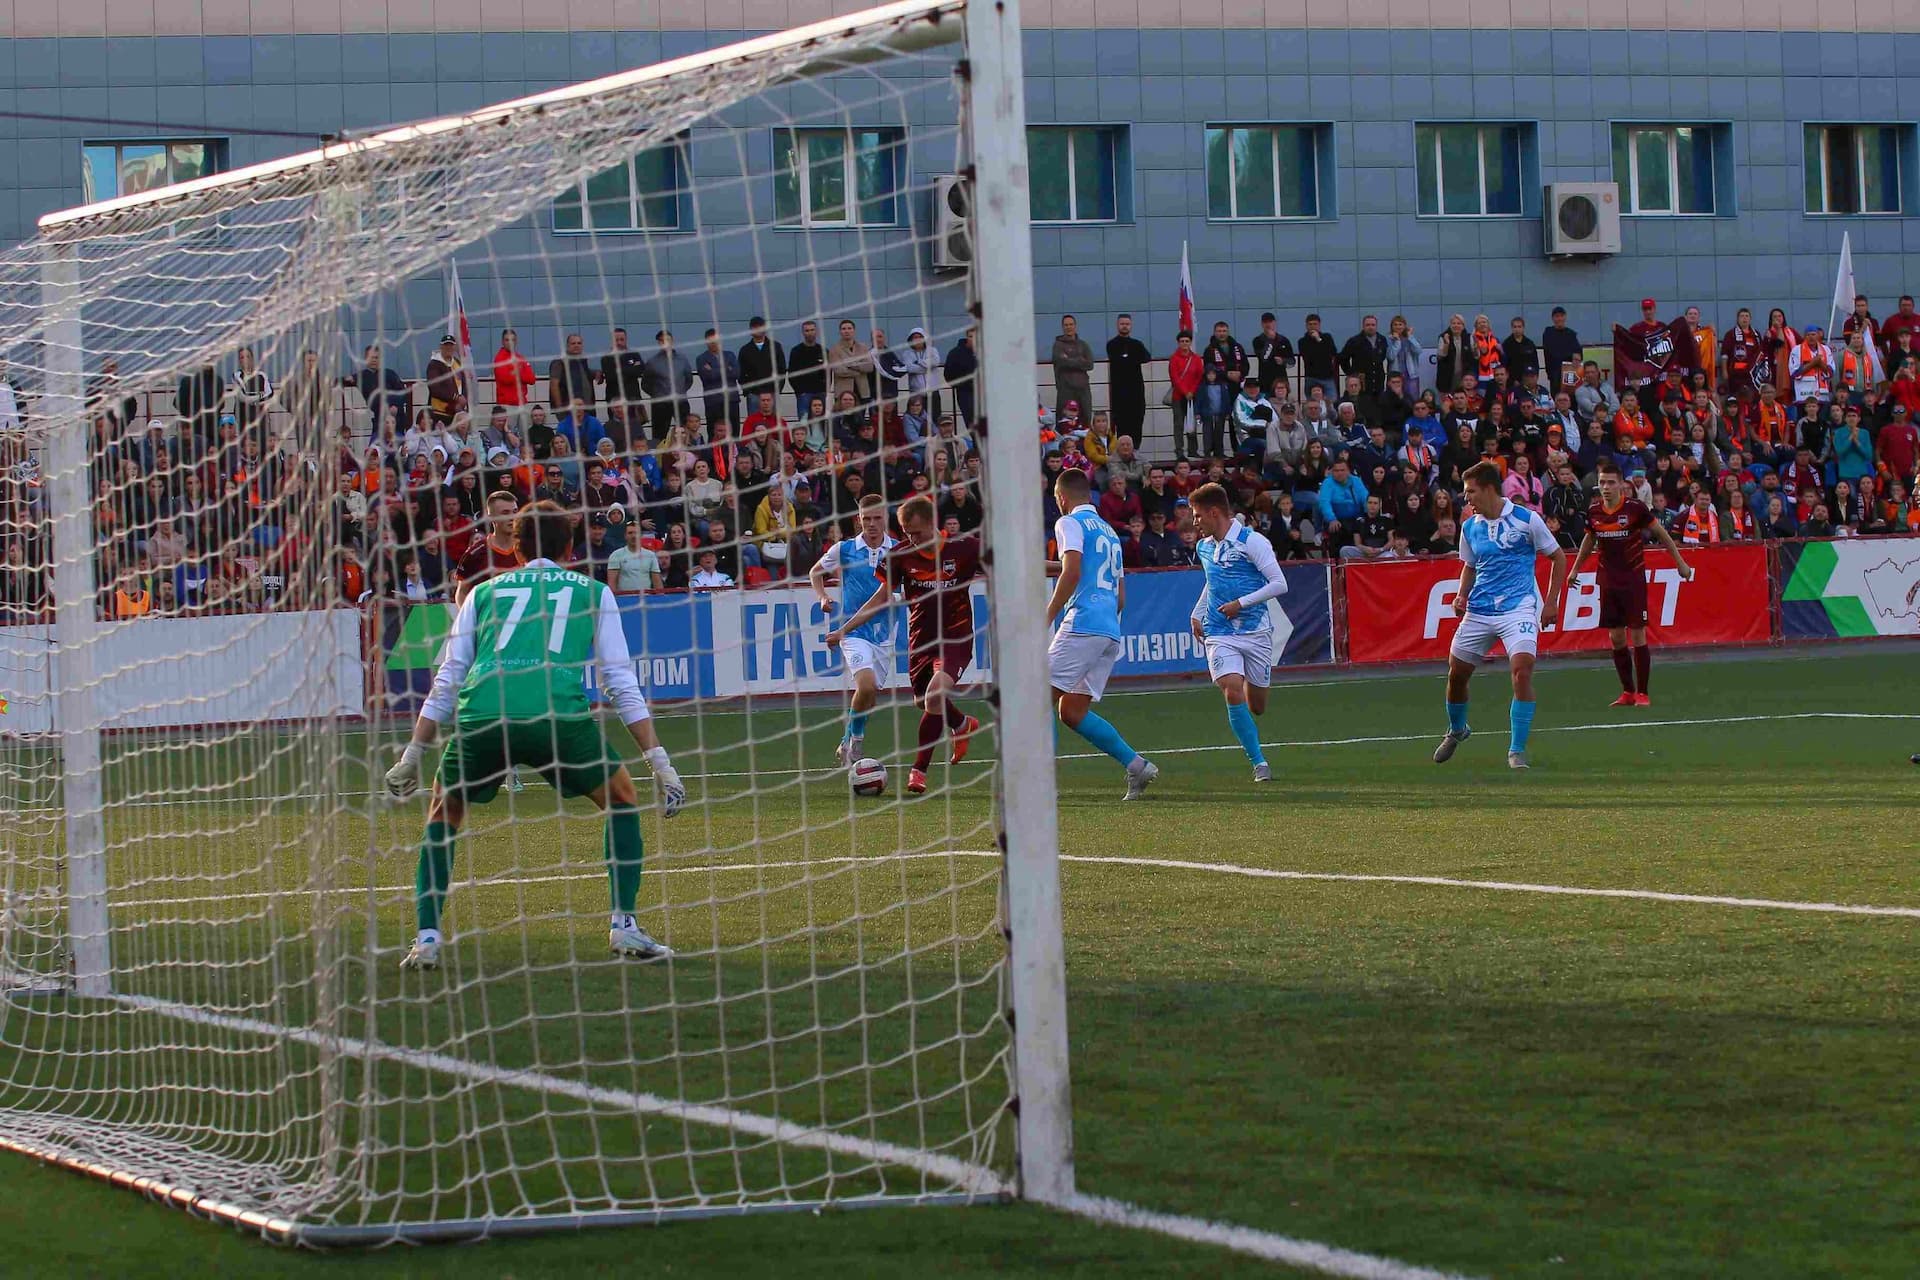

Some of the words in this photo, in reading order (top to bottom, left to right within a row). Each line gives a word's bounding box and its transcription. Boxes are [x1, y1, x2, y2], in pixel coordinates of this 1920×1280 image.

[487, 570, 589, 588] ФАТТАХОВ
[1096, 534, 1124, 596] 29
[492, 585, 574, 655] 71
[1517, 621, 1535, 634] 32
